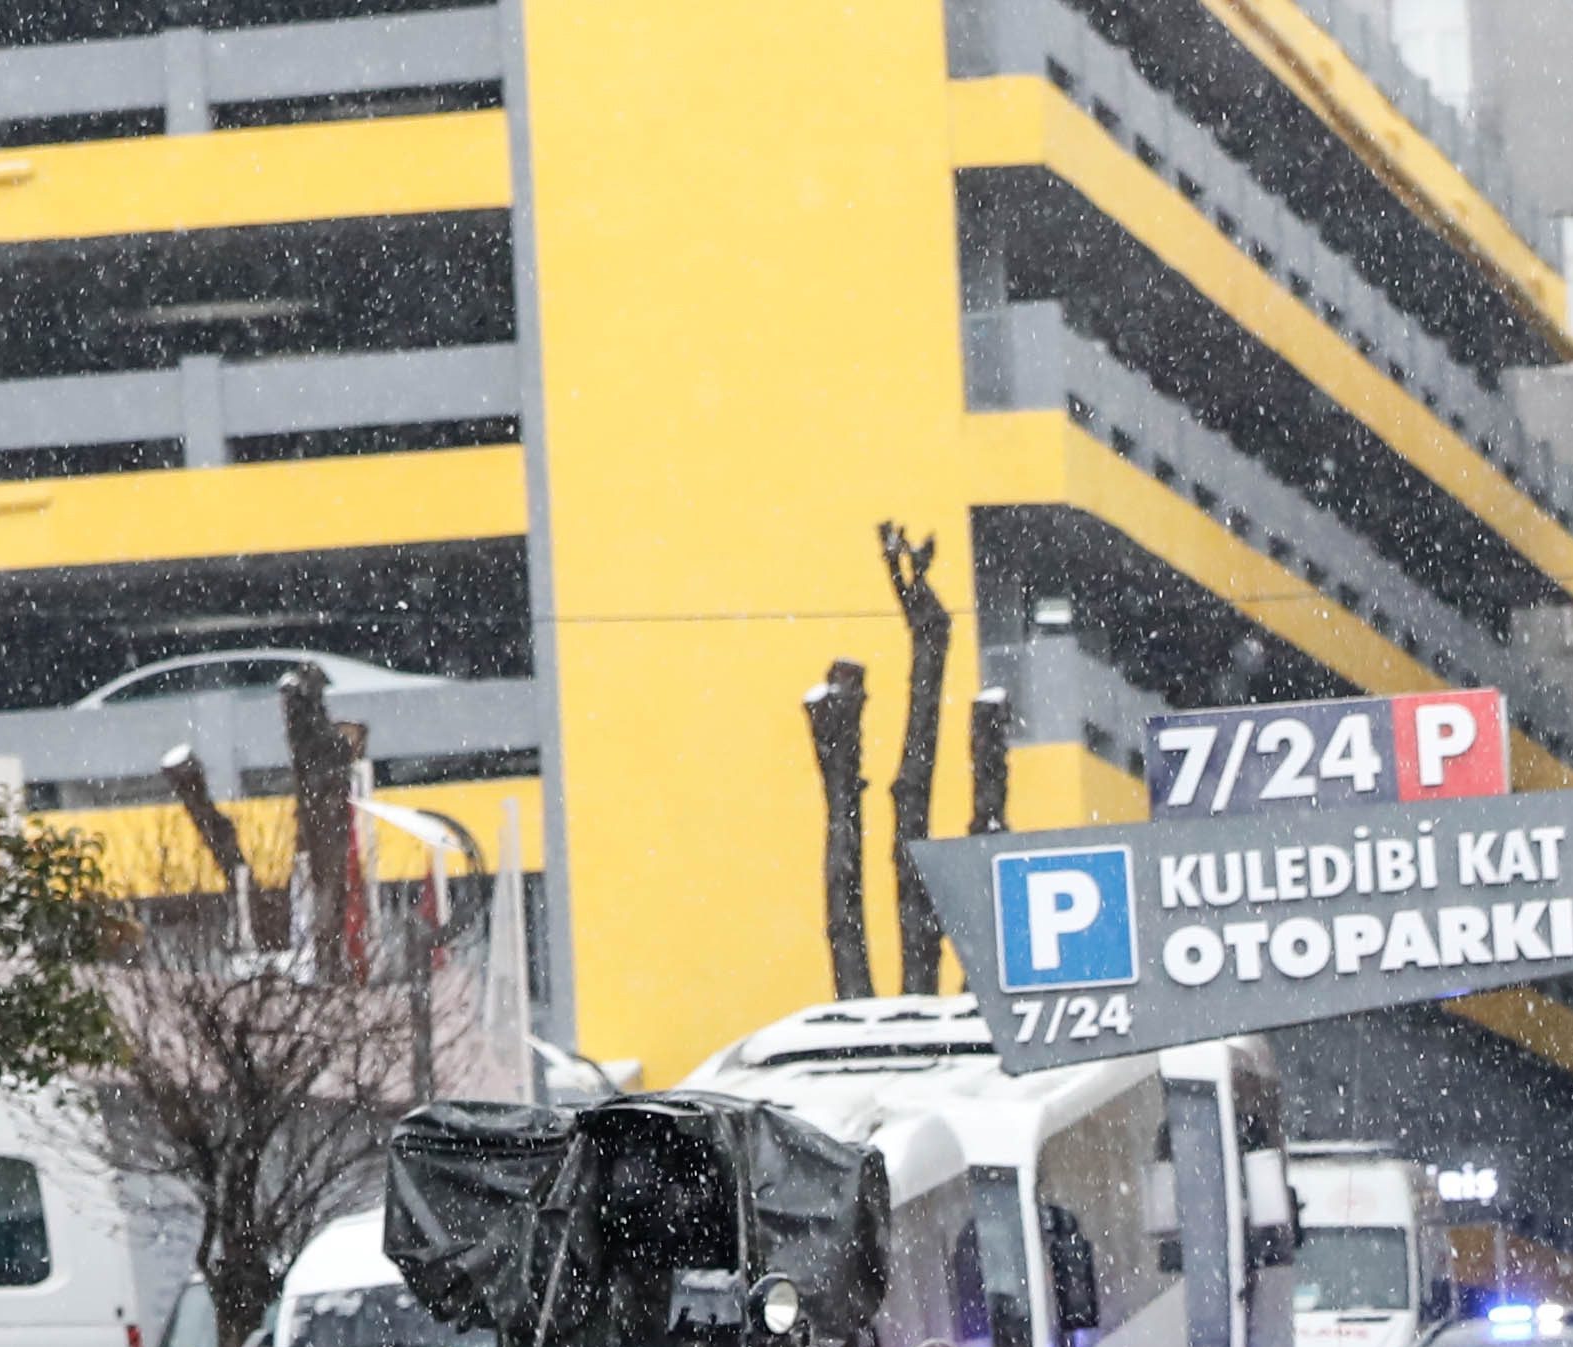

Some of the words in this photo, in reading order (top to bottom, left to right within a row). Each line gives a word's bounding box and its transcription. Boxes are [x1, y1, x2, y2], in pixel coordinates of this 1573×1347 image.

[1158, 713, 1384, 813] 7/24
[1415, 703, 1479, 788] P
[1159, 822, 1438, 909] KULEDİBİ
[1457, 826, 1566, 889] KAT
[1030, 869, 1100, 971] P
[1012, 996, 1132, 1045] 7/24
